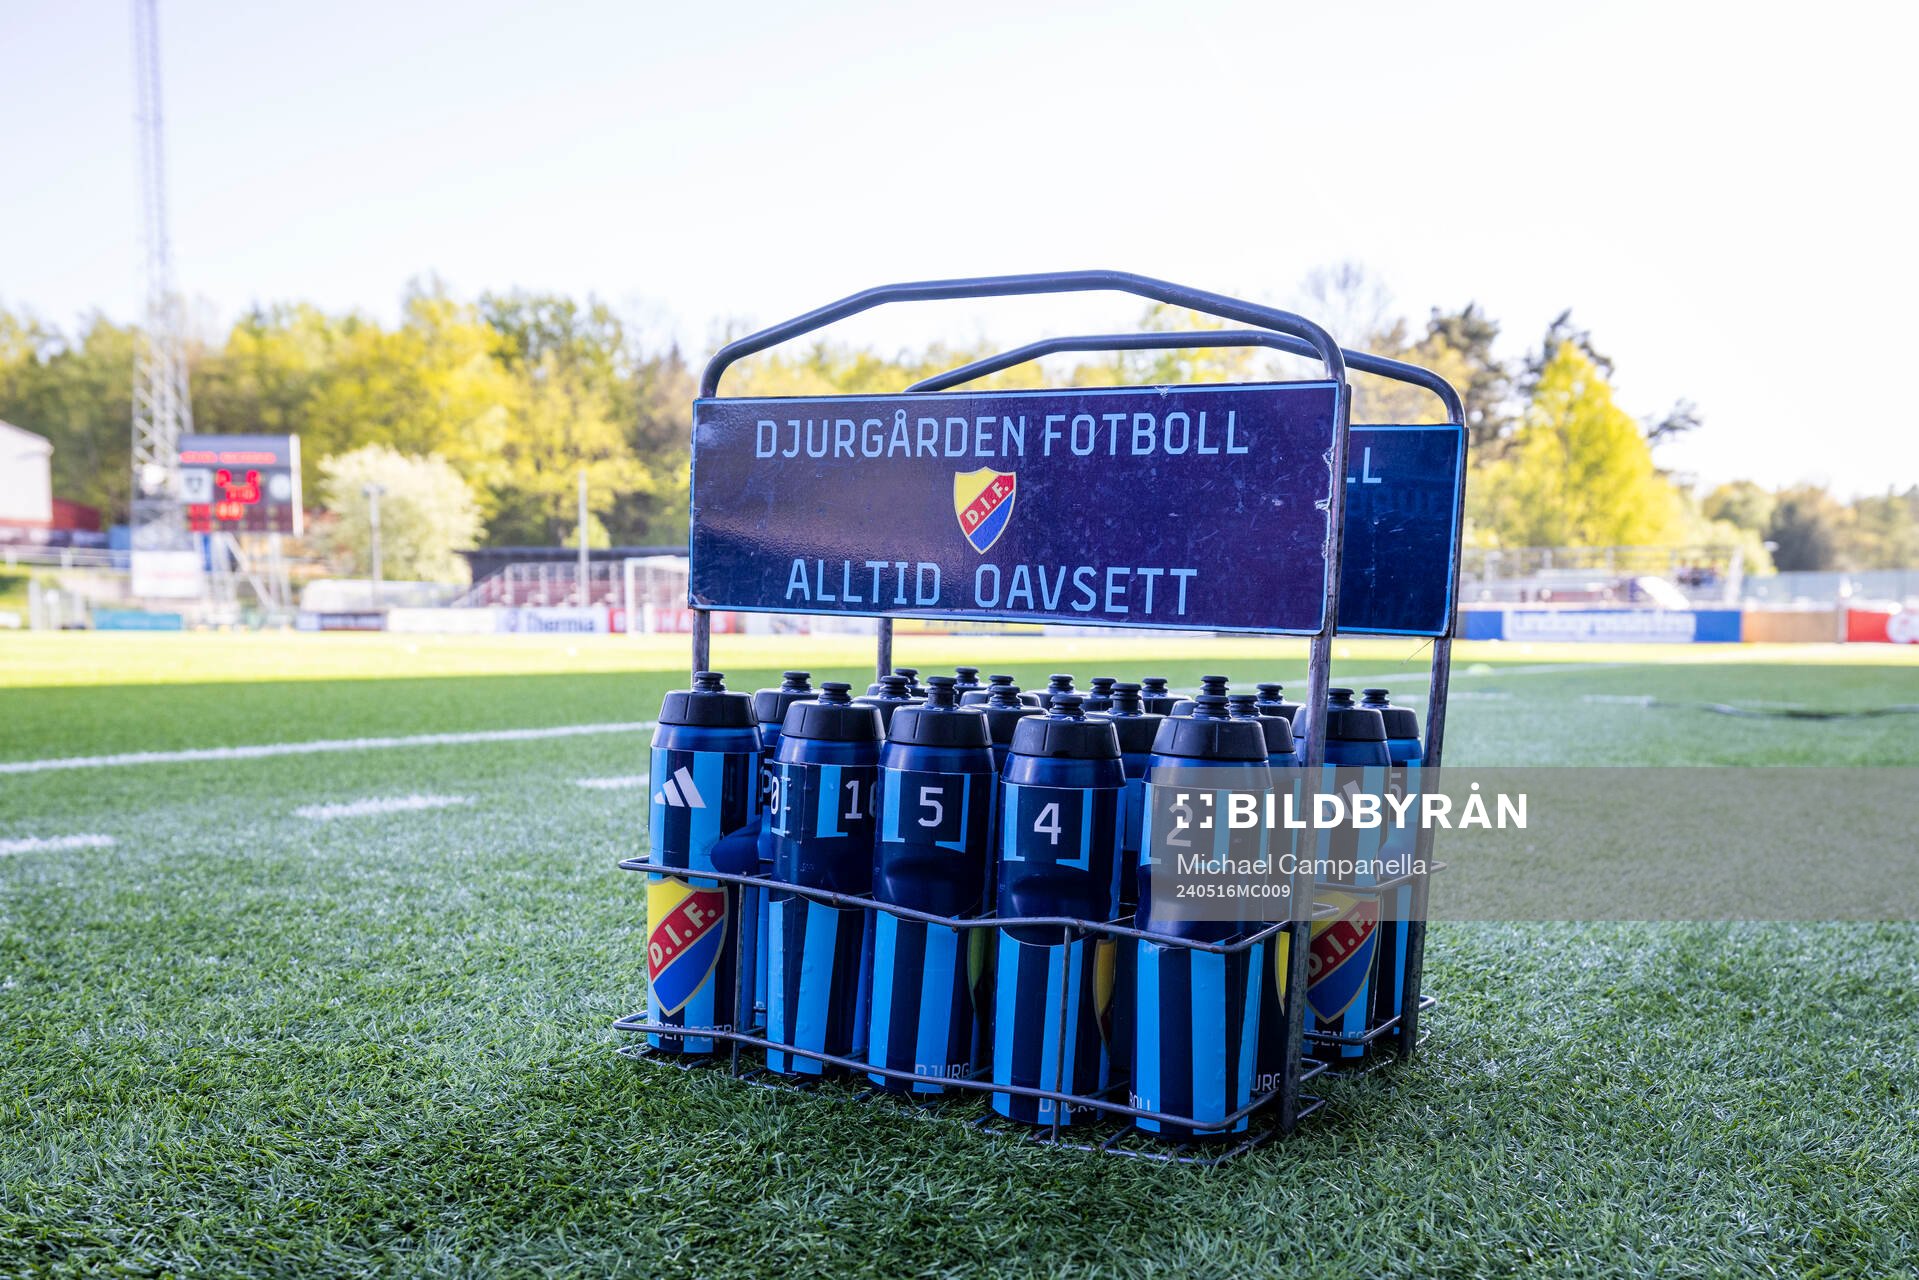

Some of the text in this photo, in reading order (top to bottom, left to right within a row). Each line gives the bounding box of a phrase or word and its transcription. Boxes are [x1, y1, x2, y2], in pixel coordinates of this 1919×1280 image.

[756, 409, 1249, 458] DJURGÅRDEN FOTBOLL
[965, 482, 1009, 526] D.I.F.
[785, 559, 1198, 616] ALLTID OAVSETT
[918, 786, 944, 827] 5
[1033, 802, 1062, 845] 4
[1166, 802, 1193, 847] 2
[650, 902, 716, 969] D.I.F.
